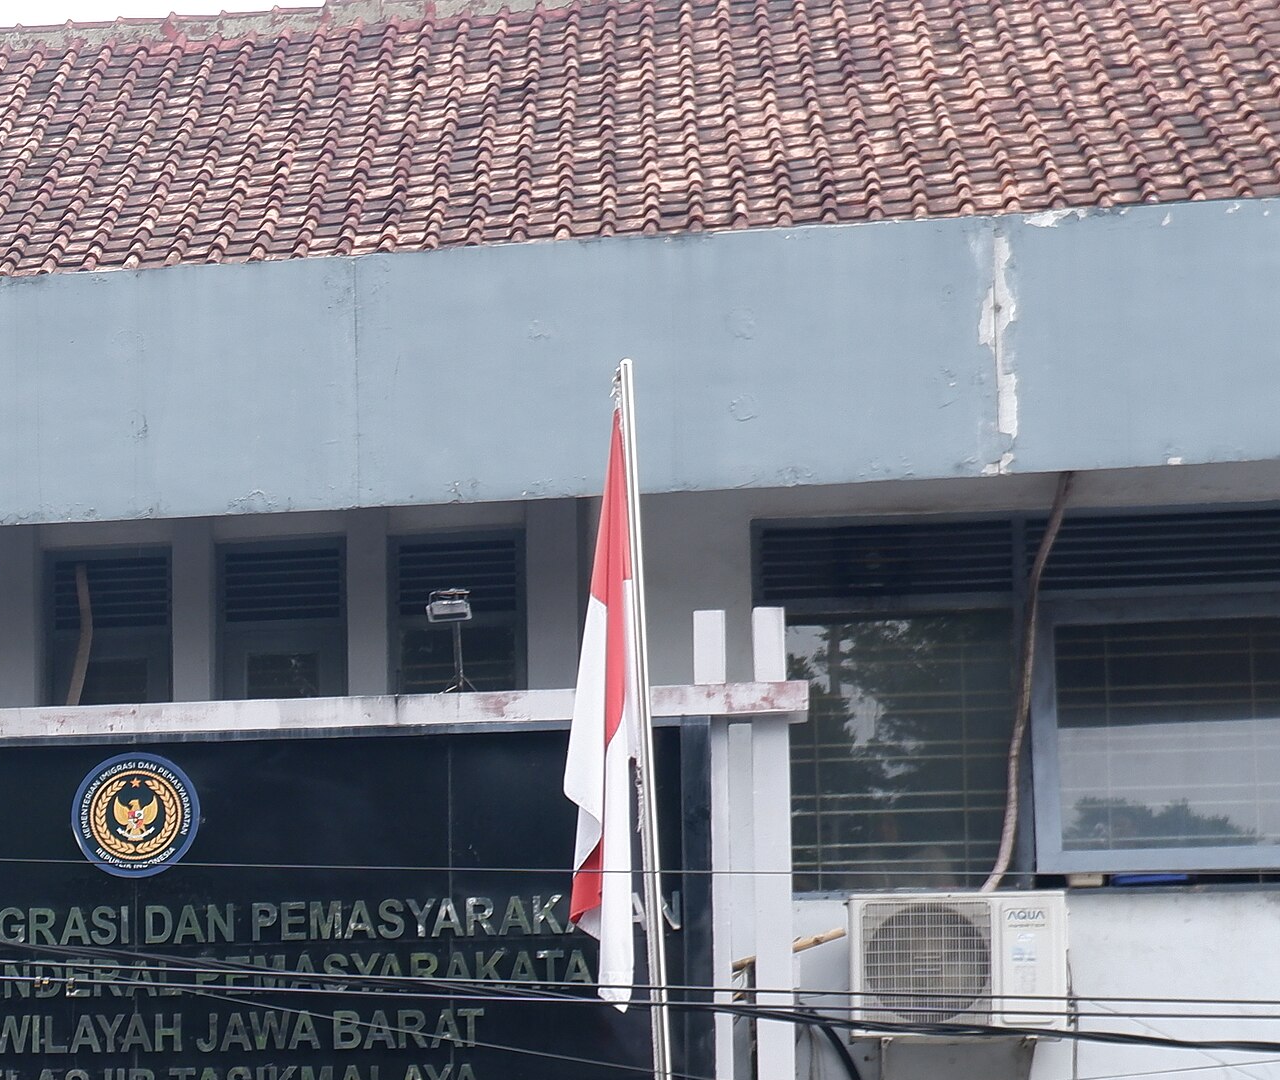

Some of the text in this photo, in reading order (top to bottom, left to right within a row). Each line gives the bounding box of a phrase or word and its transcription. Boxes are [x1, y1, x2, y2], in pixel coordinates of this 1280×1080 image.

[80, 761, 191, 839] KEMENTERIAN IMIGRASI DAN PEMASYARAKATAN
[144, 902, 235, 944] DAN
[1007, 911, 1045, 921] AQUA
[196, 1010, 321, 1053] JAWA
[334, 1007, 485, 1050] BARAT
